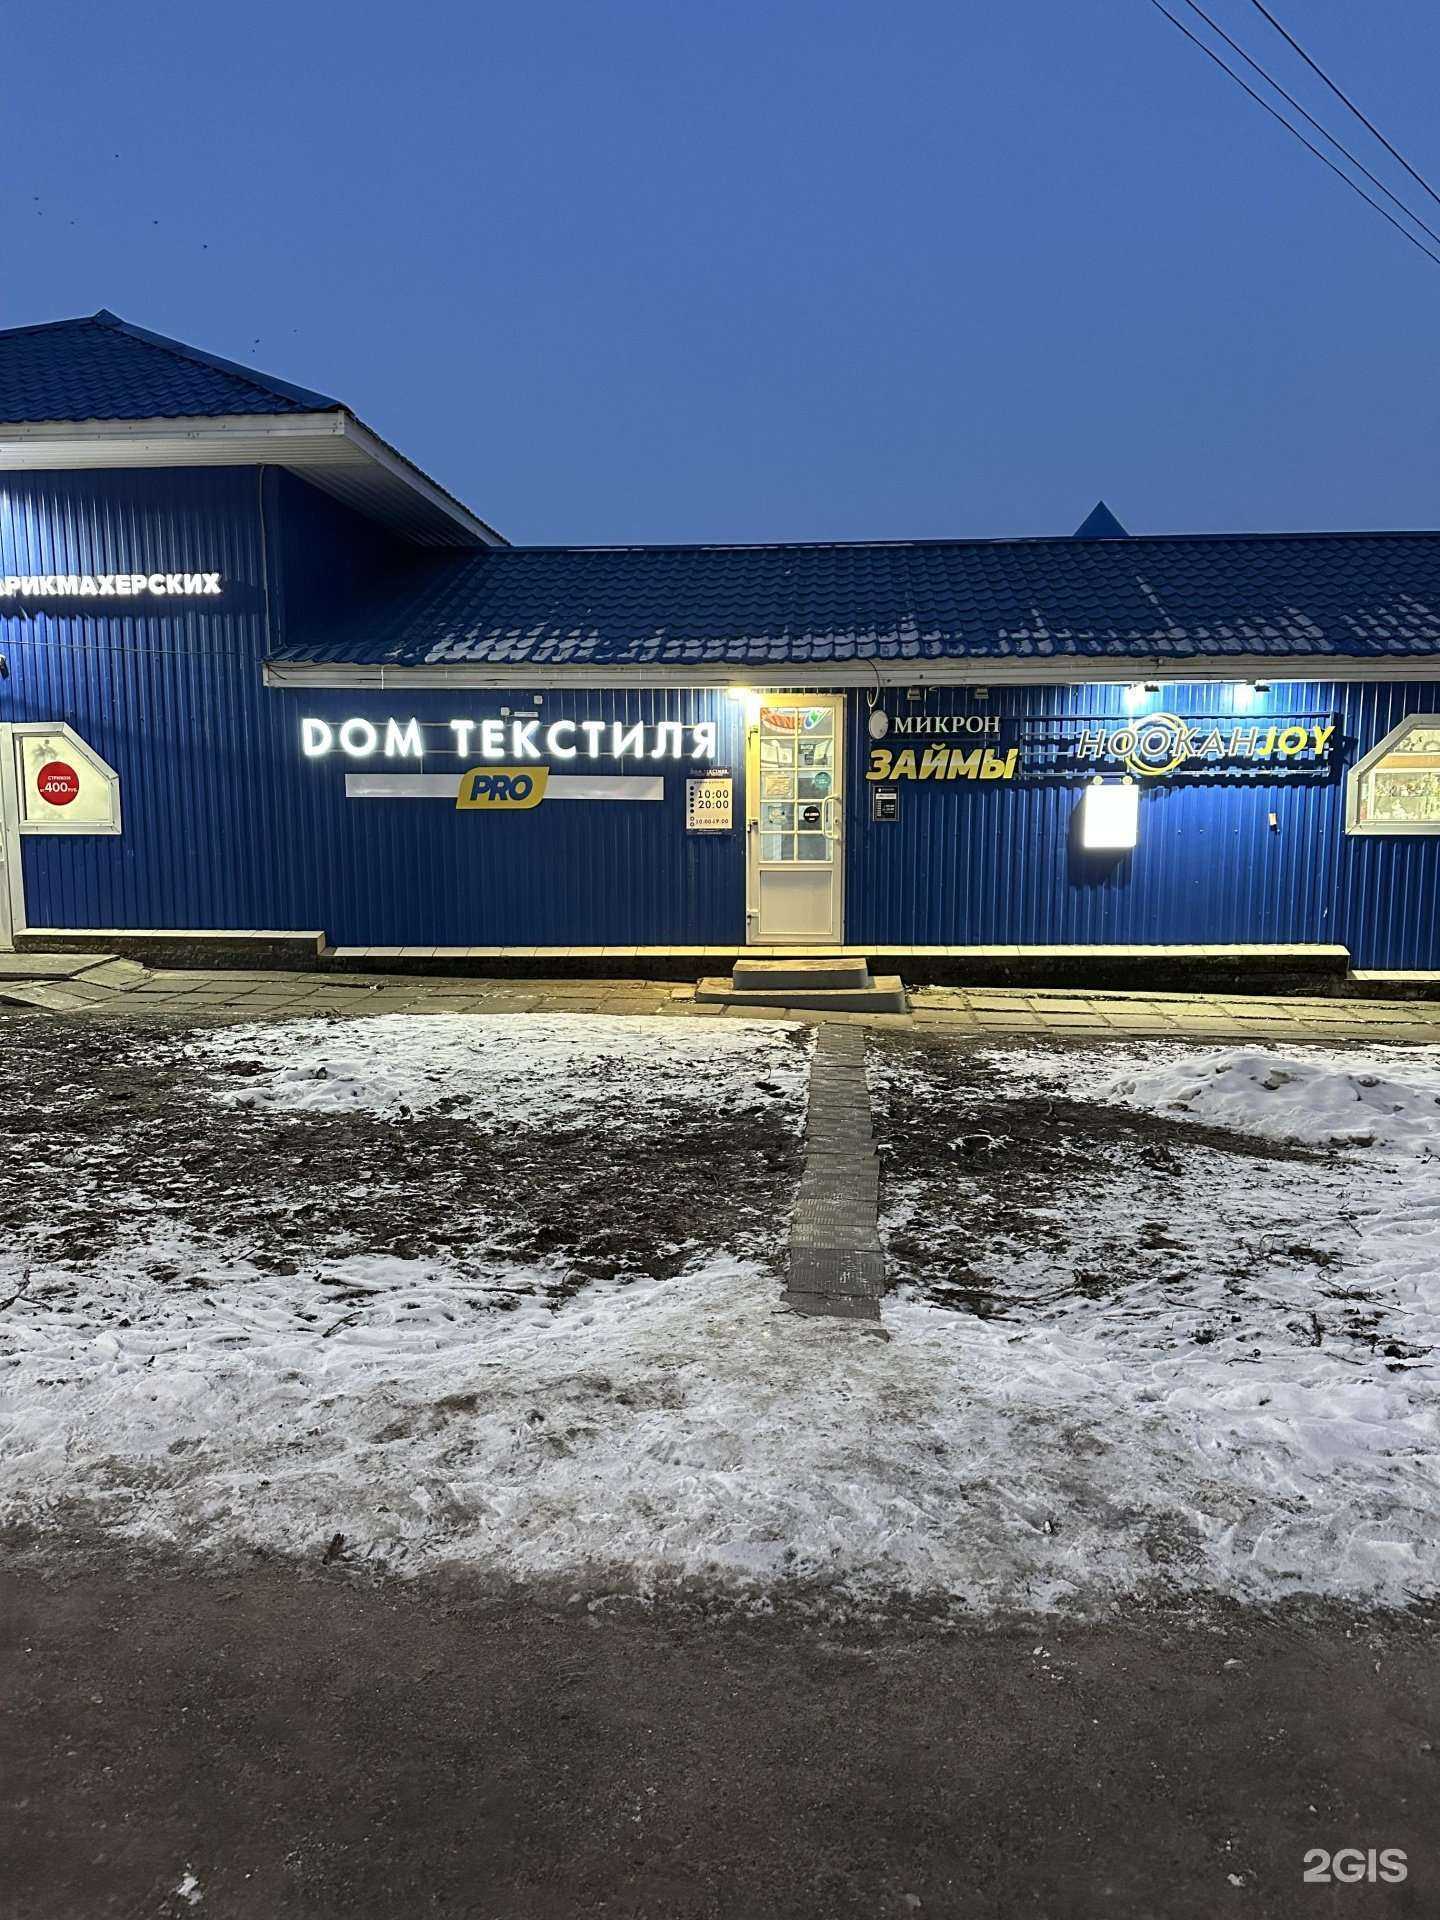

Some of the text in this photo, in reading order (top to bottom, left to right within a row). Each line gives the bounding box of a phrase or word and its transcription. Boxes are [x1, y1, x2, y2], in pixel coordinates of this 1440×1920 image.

[0, 573, 222, 596] РИКМАХЕРСКИХ
[894, 716, 1000, 733] МИКРОН
[449, 719, 717, 759] ТЕКСТИЛЯ
[865, 743, 1018, 780] ЗАЙМЫ
[45, 782, 68, 792] 400
[469, 774, 534, 801] PRO
[698, 789, 729, 799] 10:00
[698, 800, 729, 809] 20:00
